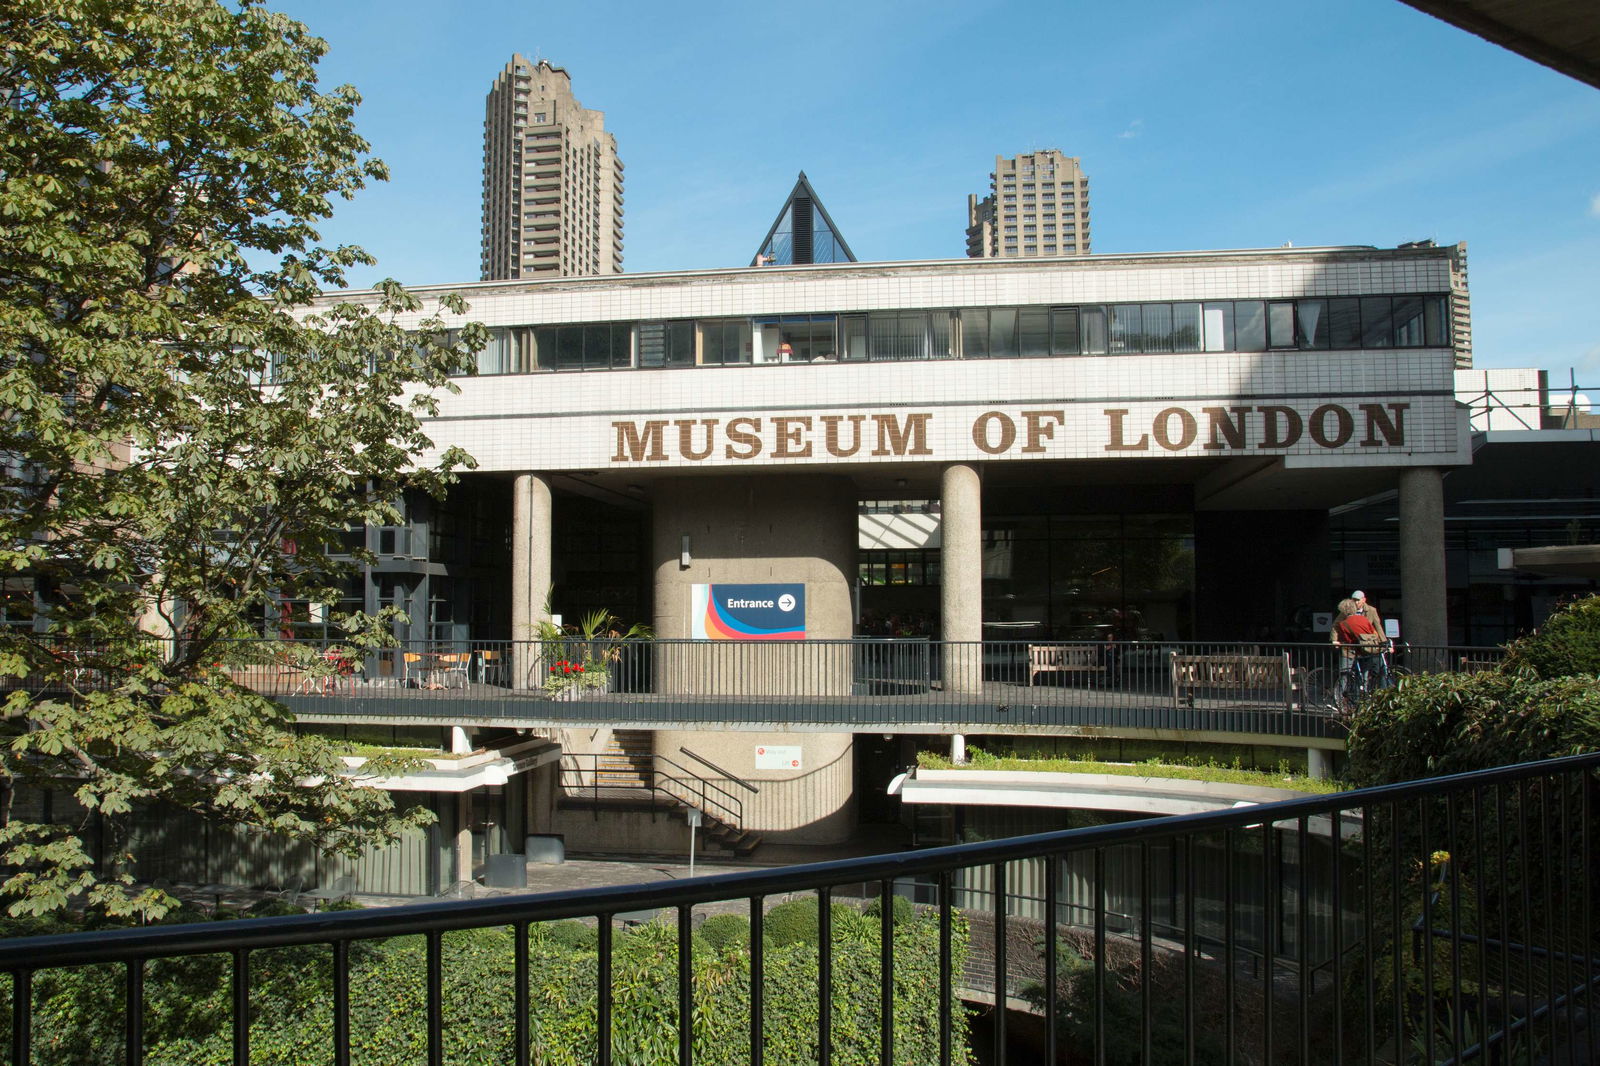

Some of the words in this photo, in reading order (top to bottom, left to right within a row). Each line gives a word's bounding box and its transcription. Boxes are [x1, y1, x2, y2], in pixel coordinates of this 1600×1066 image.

[611, 413, 933, 462] MUSEUM
[972, 410, 1065, 455] OF
[1104, 402, 1410, 451] LONDON
[727, 598, 774, 608] Entrance
